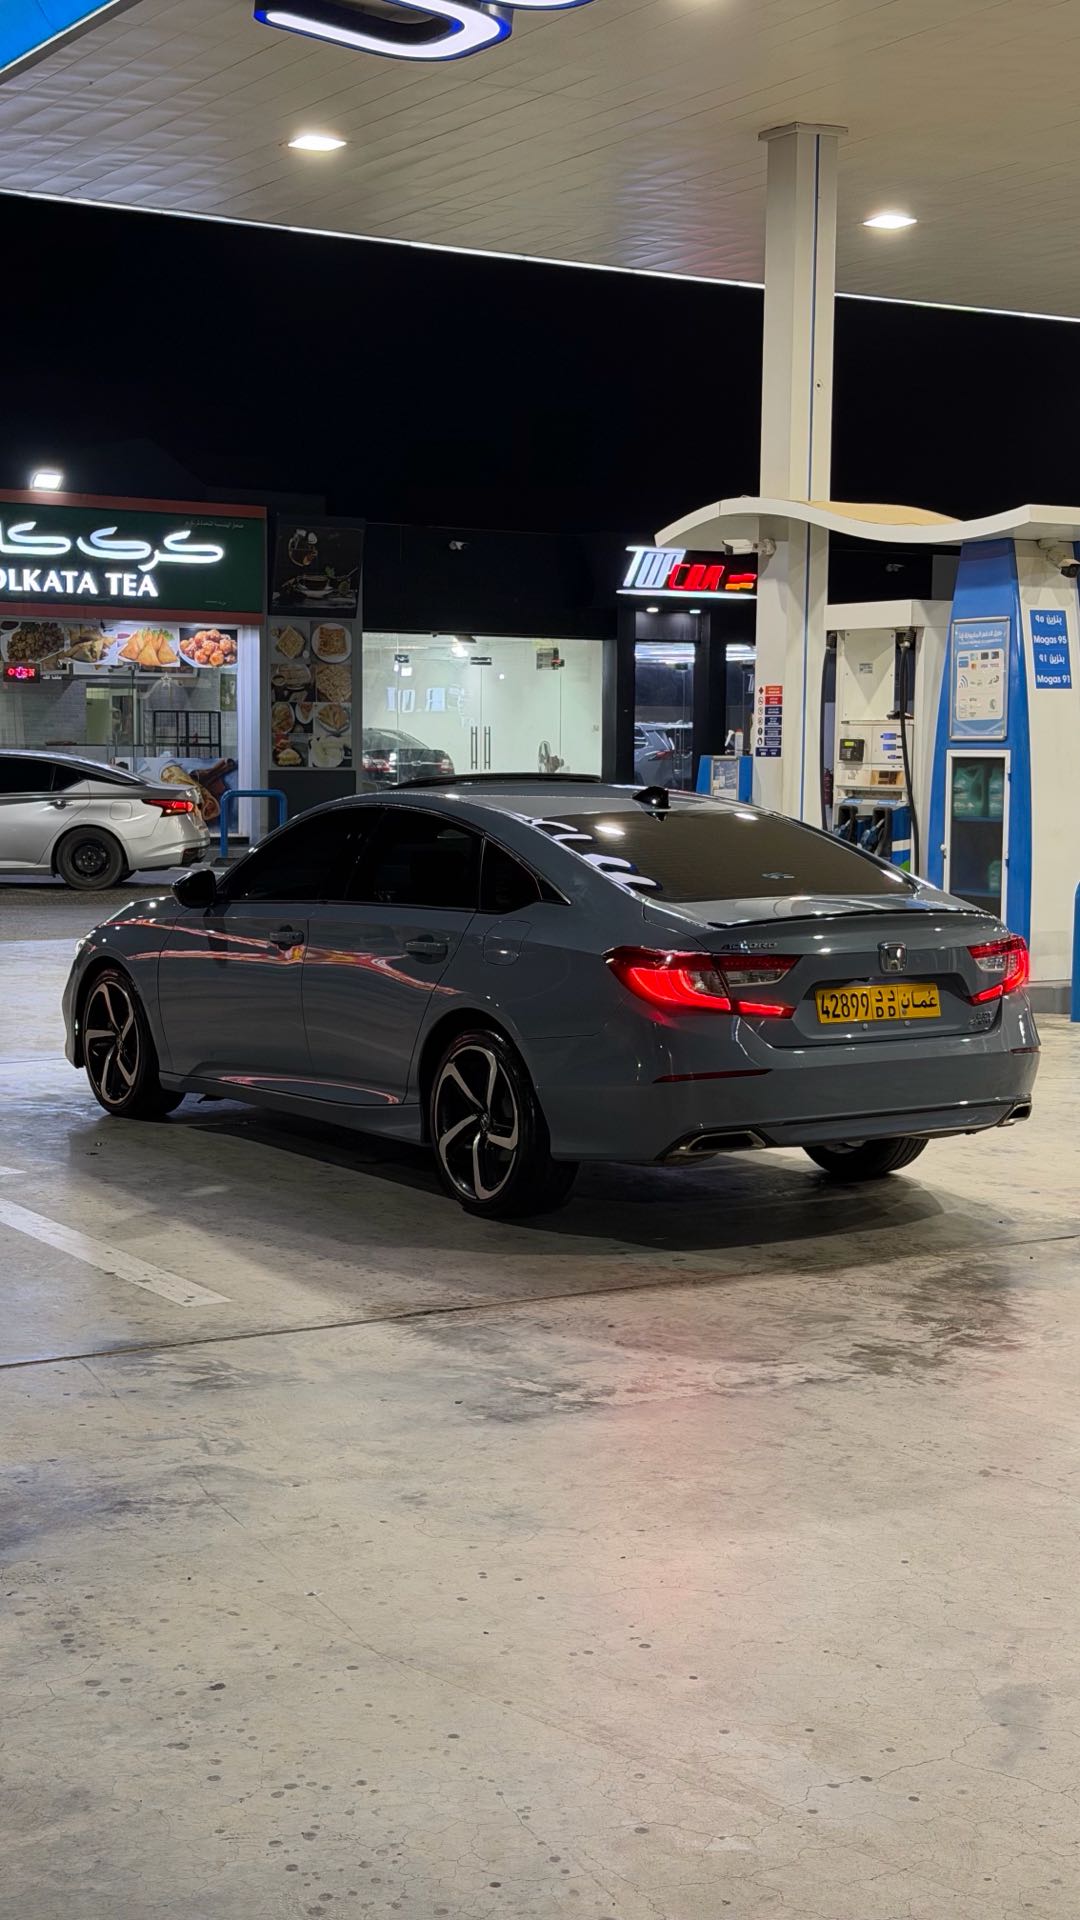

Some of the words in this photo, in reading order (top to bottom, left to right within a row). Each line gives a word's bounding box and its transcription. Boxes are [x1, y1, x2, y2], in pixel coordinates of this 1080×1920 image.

[622, 545, 687, 589] TOP
[667, 563, 725, 591] CAR
[105, 572, 159, 598] TEA
[1033, 635, 1057, 646] Mogas
[1057, 636, 1067, 644] 95
[1036, 675, 1062, 685] Mogas
[1062, 675, 1071, 683] 91
[820, 992, 871, 1019] 42899
